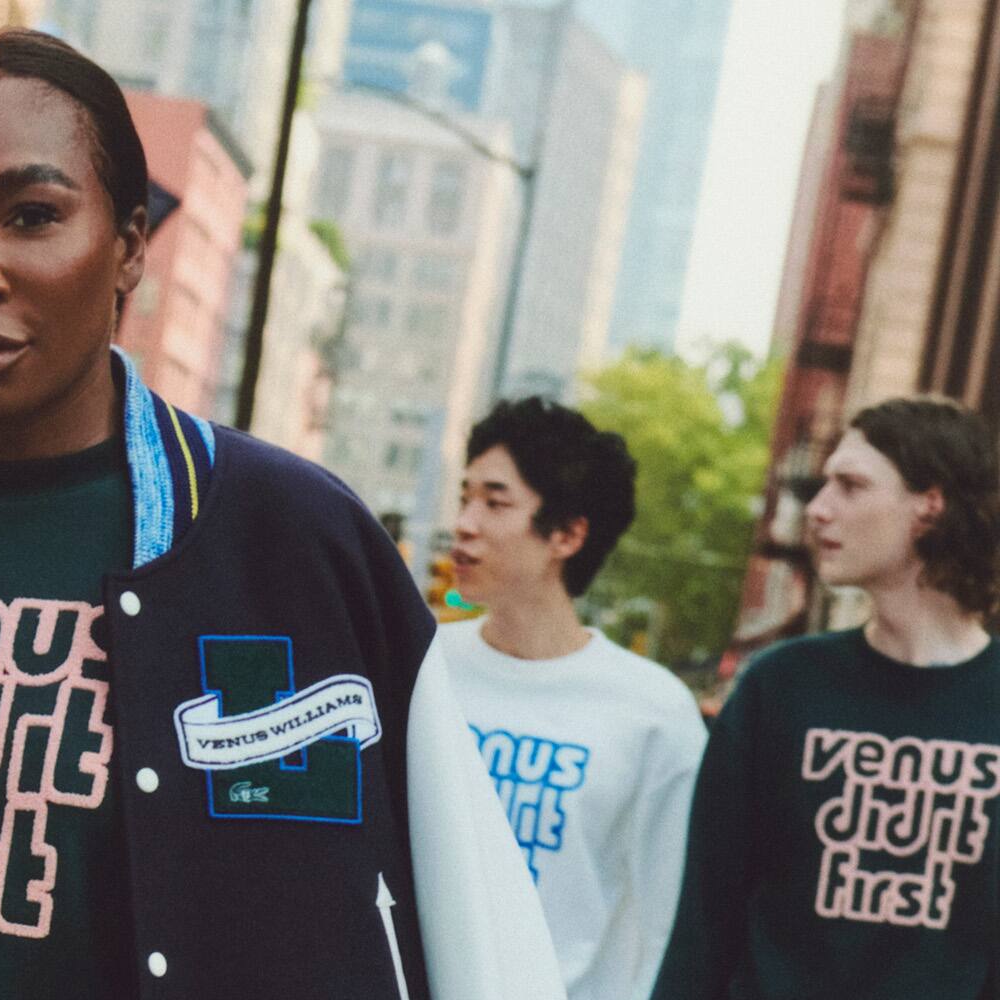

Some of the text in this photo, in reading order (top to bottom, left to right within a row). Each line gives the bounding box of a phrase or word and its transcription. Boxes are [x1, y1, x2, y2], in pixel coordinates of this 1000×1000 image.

[7, 678, 113, 809] it
[197, 693, 363, 750] VENUS WILLIAMS
[467, 723, 590, 791] nus
[802, 727, 1000, 798] venus
[815, 778, 990, 864] did it
